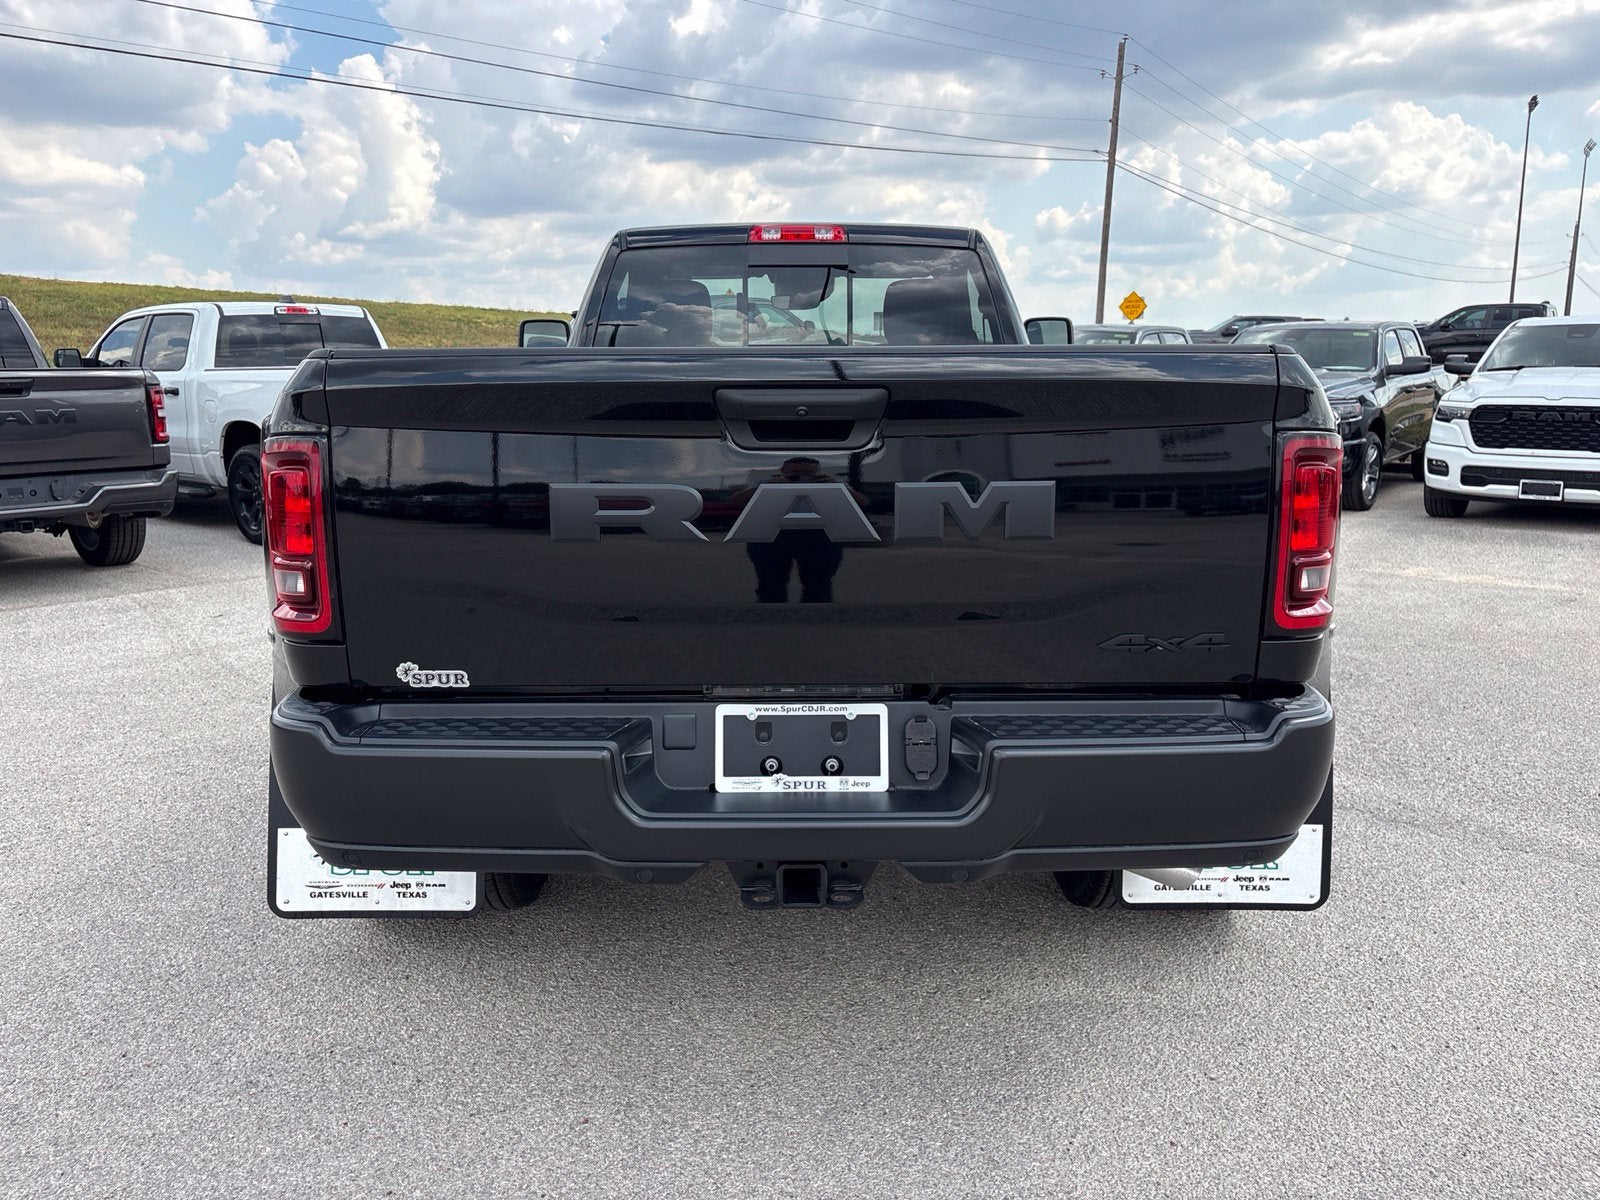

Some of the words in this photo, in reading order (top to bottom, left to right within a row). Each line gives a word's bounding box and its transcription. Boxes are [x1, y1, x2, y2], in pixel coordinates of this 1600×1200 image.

[1511, 411, 1591, 421] RAM
[549, 480, 1056, 543] RAM
[412, 673, 467, 685] SPUR
[755, 705, 848, 714] www.SpurCDJR.com
[782, 780, 827, 790] SPUR
[851, 780, 871, 788] Jeep
[1233, 875, 1255, 884] Jeep
[390, 881, 411, 890] Jeep
